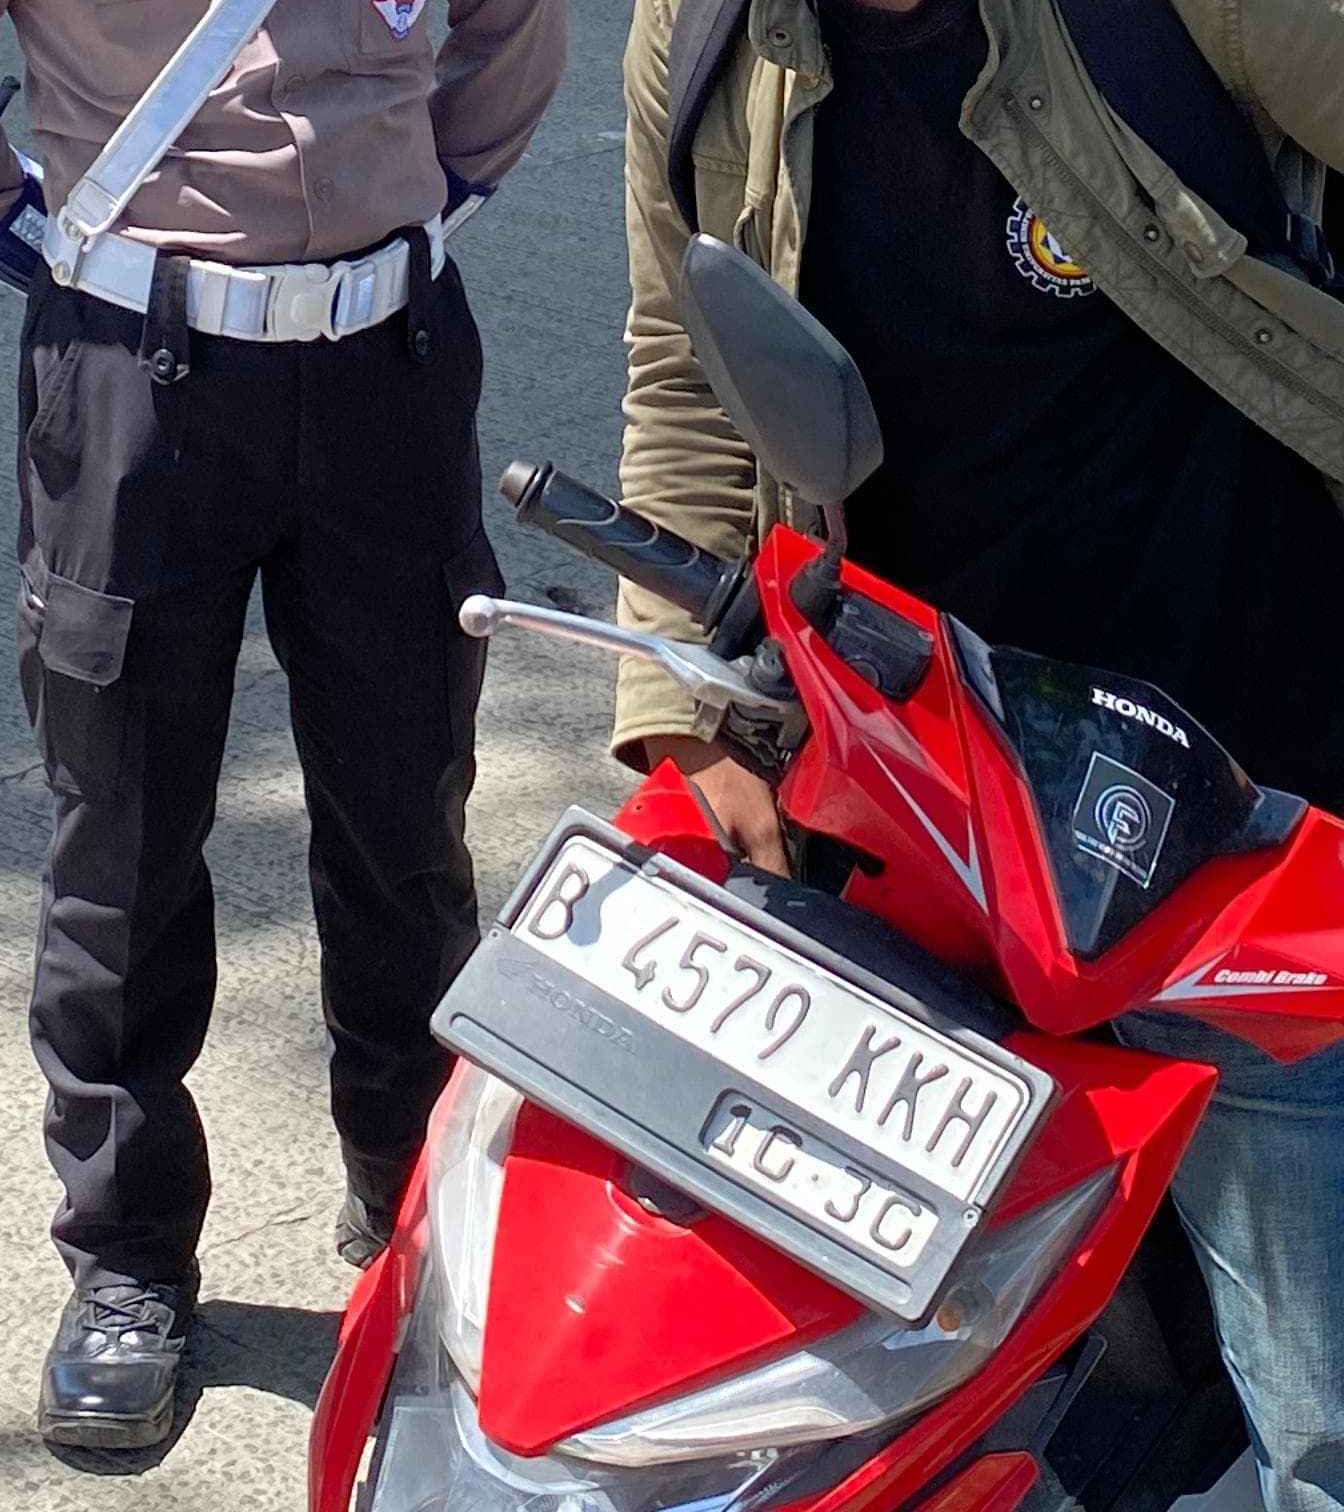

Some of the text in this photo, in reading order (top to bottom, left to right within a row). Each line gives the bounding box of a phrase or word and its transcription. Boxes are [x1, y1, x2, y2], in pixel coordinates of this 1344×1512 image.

[1091, 687, 1191, 749] HONDA
[1213, 968, 1329, 986] Combi Brake
[526, 973, 638, 1055] HONDA
[528, 862, 998, 1169] B 4579 KKH
